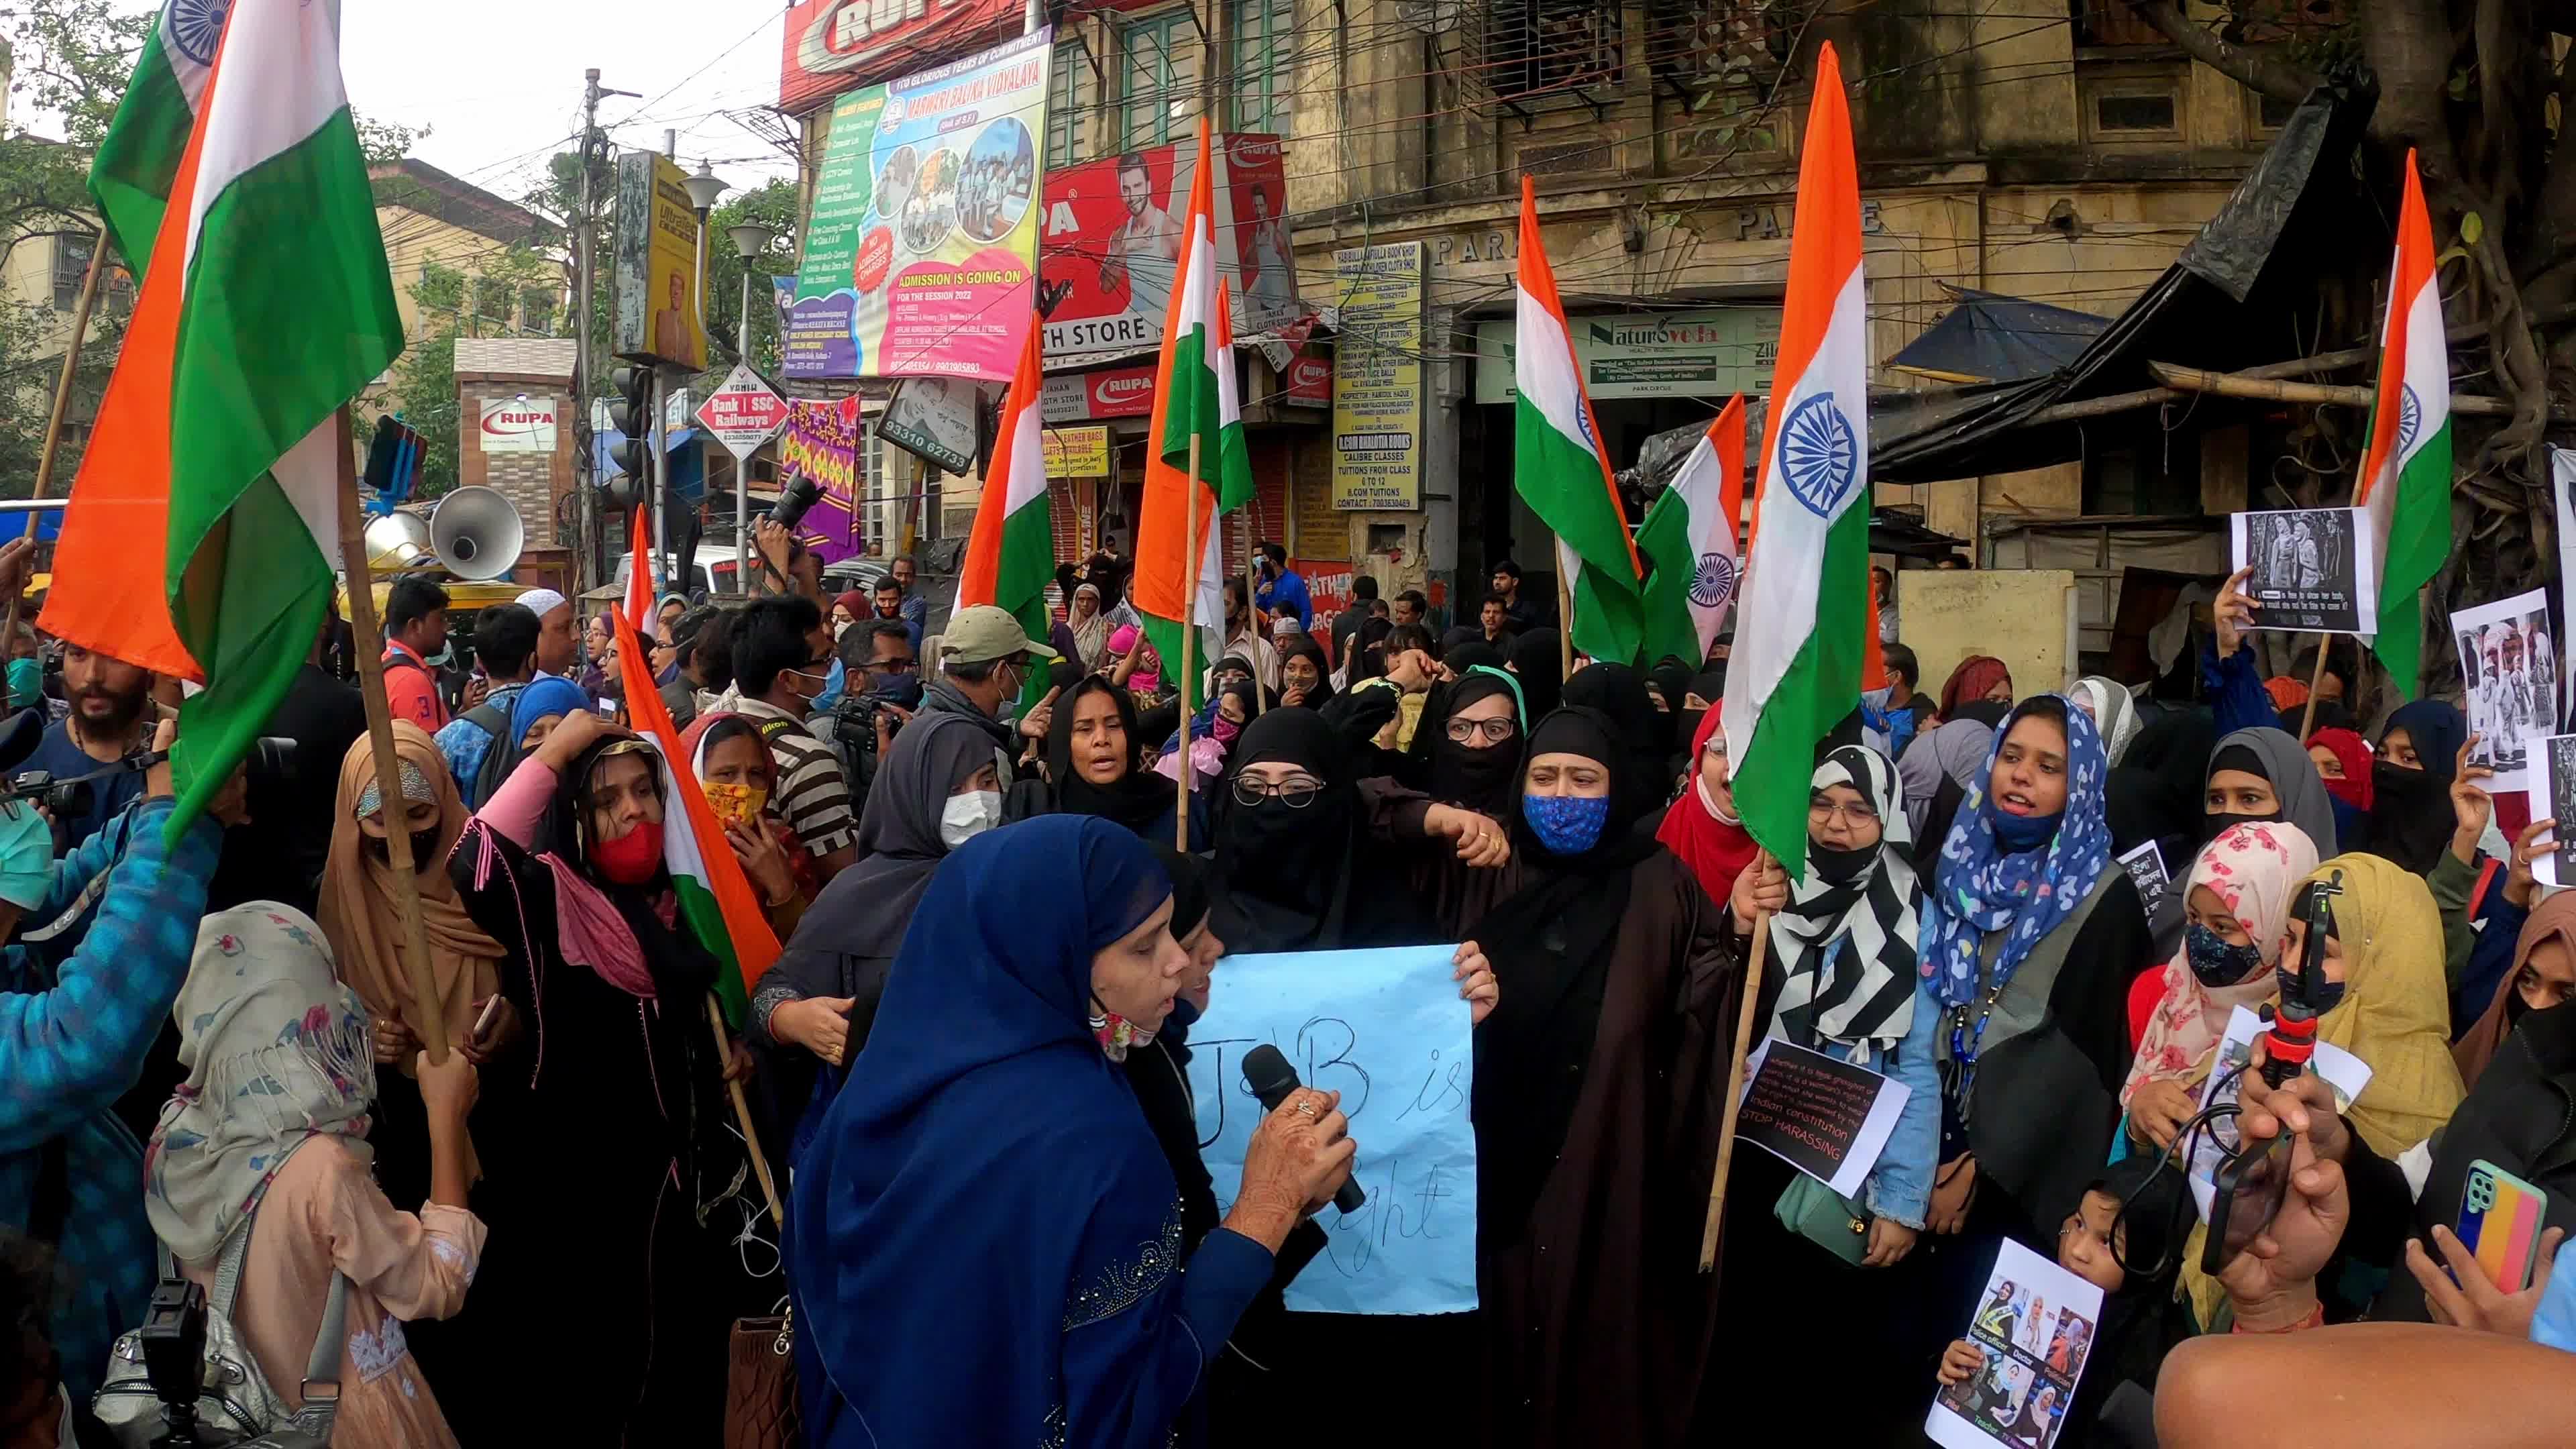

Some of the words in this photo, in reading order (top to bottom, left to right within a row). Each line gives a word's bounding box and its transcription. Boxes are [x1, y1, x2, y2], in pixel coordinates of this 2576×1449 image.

[911, 66, 950, 87] GLORIOUS
[953, 58, 976, 76] YEARS
[978, 55, 988, 68] OF
[989, 33, 1042, 62] COMMITMENT
[907, 89, 950, 121] MARWARI
[987, 58, 1040, 99] VIDYALAYA
[1735, 200, 1883, 241] PAE
[869, 236, 877, 250] NO
[1403, 245, 1415, 257] SHOP
[859, 241, 888, 269] ADMISSION
[860, 253, 886, 280] CHARGES
[899, 273, 951, 288] ADMISSION
[955, 273, 963, 285] IS
[967, 271, 1001, 284] GOING
[1005, 270, 1020, 282] ON
[898, 293, 910, 301] FOR
[912, 292, 923, 301] THE
[925, 291, 953, 301] SESSION
[1073, 317, 1146, 345] STORE
[1590, 322, 1721, 347] Naturoveda
[1303, 365, 1326, 376] RUPA
[1046, 384, 1070, 394] JAHAN
[1110, 376, 1153, 393] RUPA
[712, 397, 738, 413] Bank
[751, 396, 774, 411] SSC
[1061, 394, 1085, 404] STORE
[500, 413, 554, 423] RUPA
[715, 414, 768, 428] Railways
[885, 420, 924, 447] 93310
[926, 442, 966, 468] 62733
[1359, 435, 1388, 449] BHALOTIA
[1389, 435, 1410, 449] BOOKS
[1344, 453, 1372, 462] CALIBRE
[1375, 452, 1404, 461] CLASSES
[1338, 467, 1368, 475] TUITIONS
[1369, 466, 1387, 474] FROM
[1390, 466, 1410, 474] CLASS
[1379, 477, 1385, 485] 12
[1348, 488, 1368, 497] B.COM
[1370, 488, 1399, 496] TUITIONS
[1338, 499, 1366, 508] CONTACT
[418, 696, 430, 718] 3
[1395, 1049, 1465, 1122] is
[1750, 1094, 1784, 1113] Indian
[1786, 1108, 1849, 1141] constitution
[1739, 1108, 1773, 1123] STOP
[1775, 1118, 1841, 1161] HARASSING
[1986, 1332, 2008, 1351] officer
[2012, 1348, 2035, 1366] Doctor
[1974, 1414, 1999, 1435] Teacher
